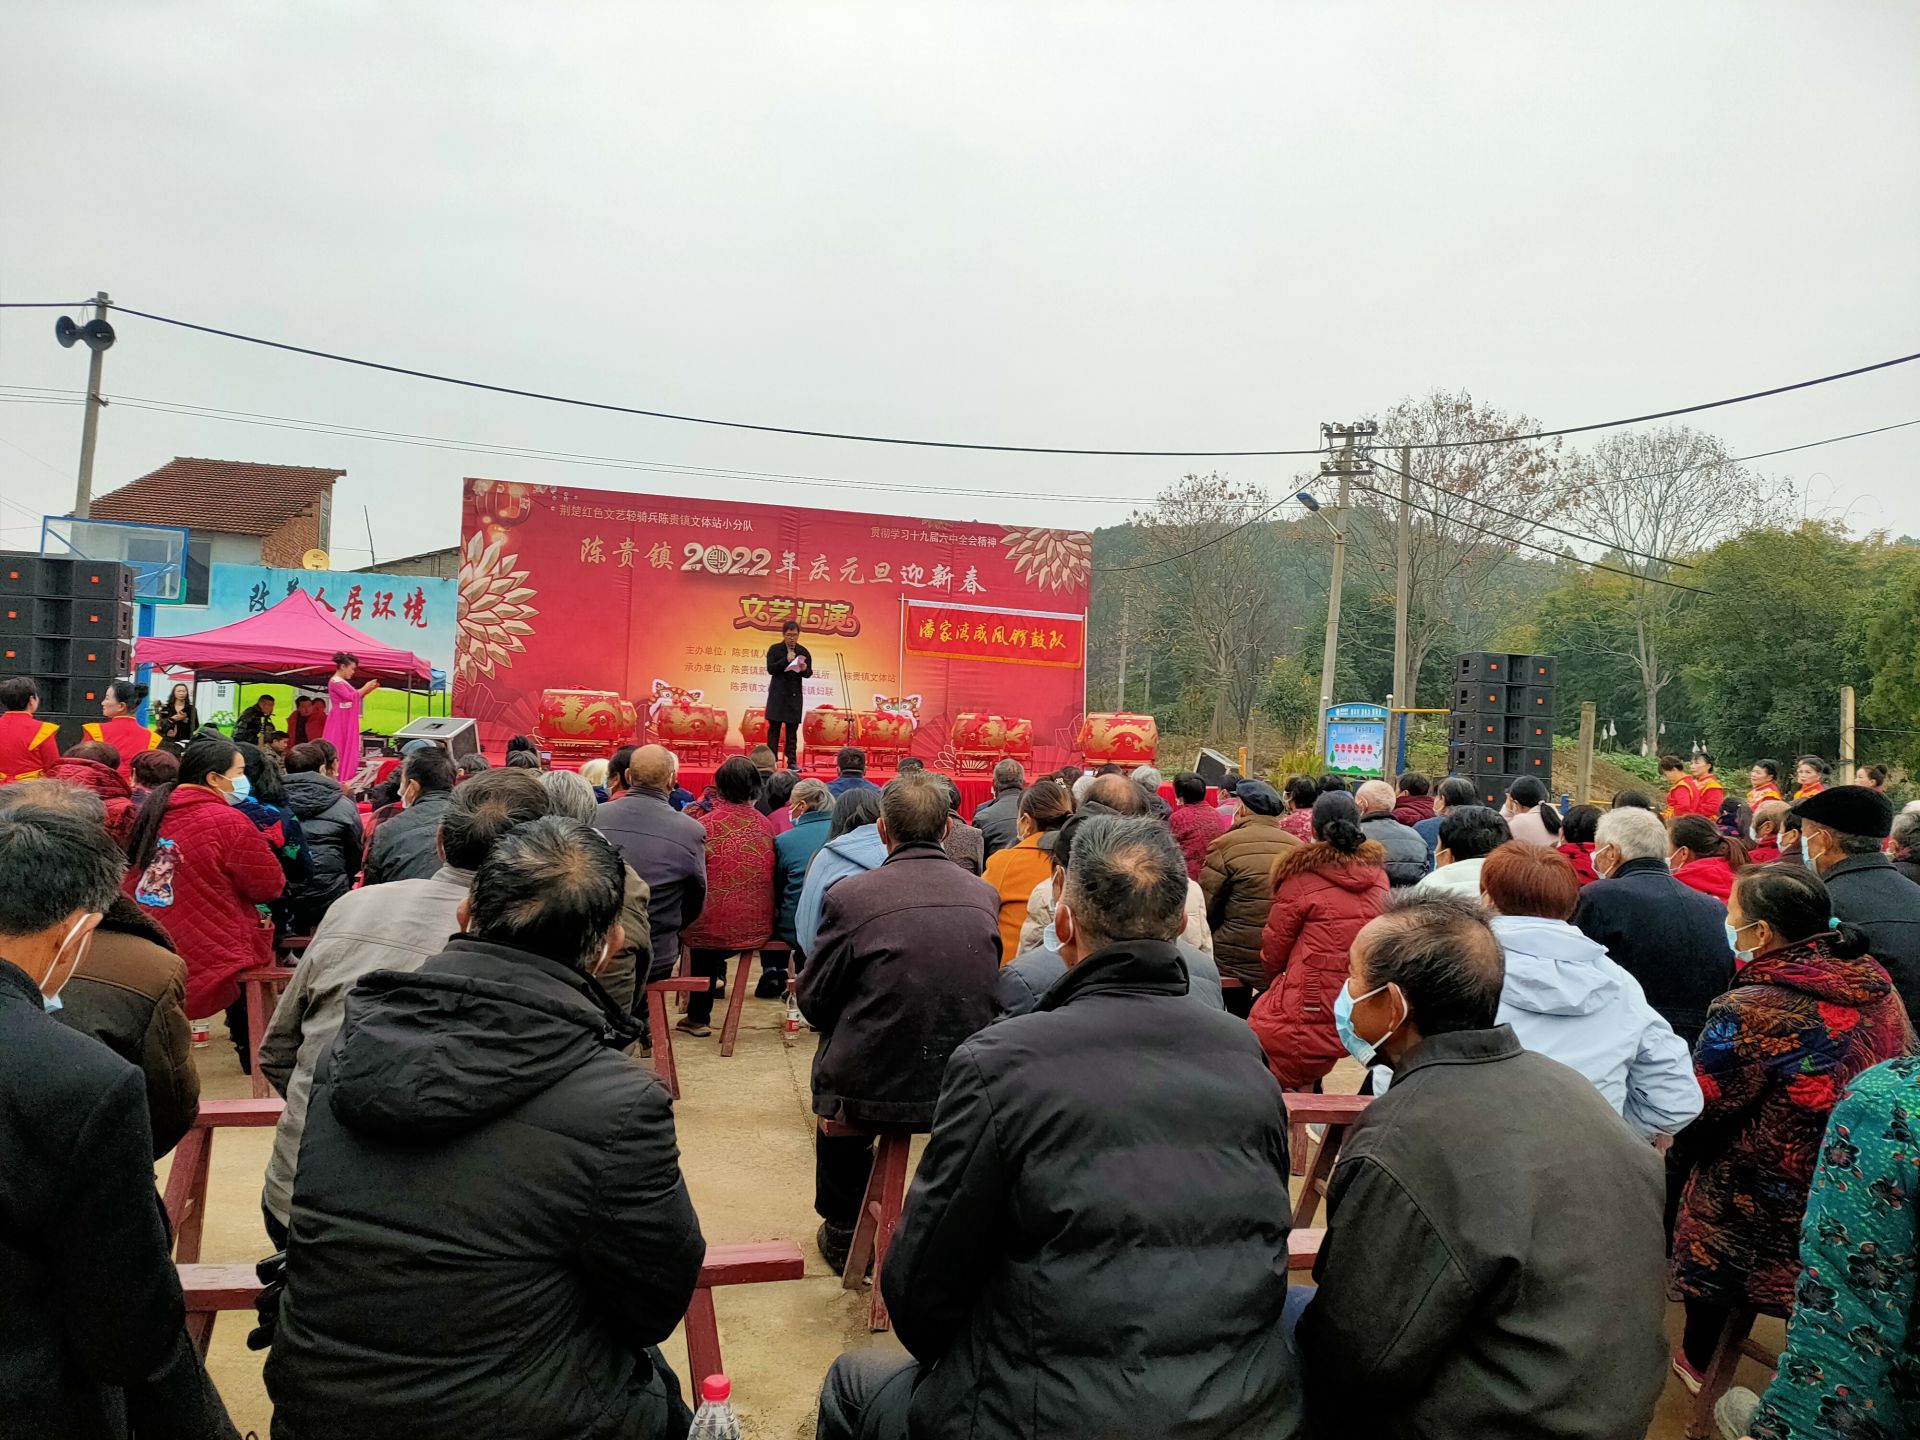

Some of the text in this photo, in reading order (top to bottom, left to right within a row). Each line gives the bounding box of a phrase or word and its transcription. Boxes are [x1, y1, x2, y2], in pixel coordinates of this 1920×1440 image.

[559, 504, 754, 532] 荆楚红色文艺轻骑兵陈贵镇文体站小分队
[870, 526, 998, 548] 贯彻学习十九届六中全会精神
[735, 596, 859, 636] 文艺汇演
